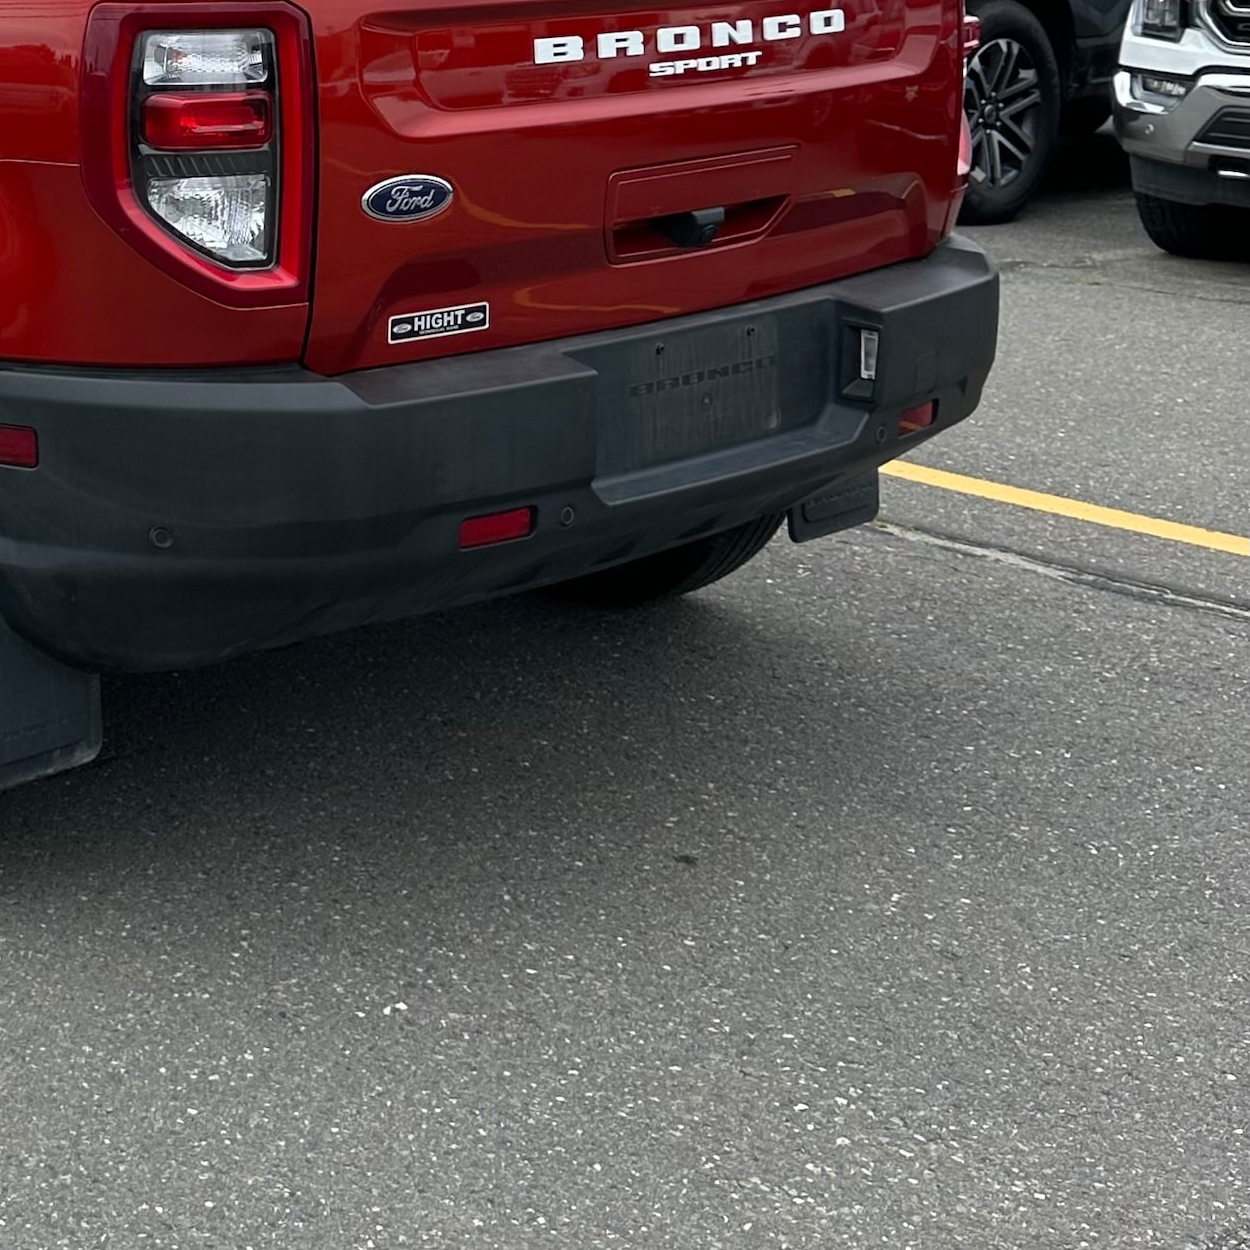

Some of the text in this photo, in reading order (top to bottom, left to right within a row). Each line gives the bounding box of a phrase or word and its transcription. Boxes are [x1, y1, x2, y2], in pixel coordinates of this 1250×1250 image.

[534, 9, 845, 64] BRONCO
[649, 51, 762, 77] SPORT
[386, 184, 436, 212] Ford
[414, 310, 465, 331] HIGHT
[630, 356, 775, 398] BRONCO
